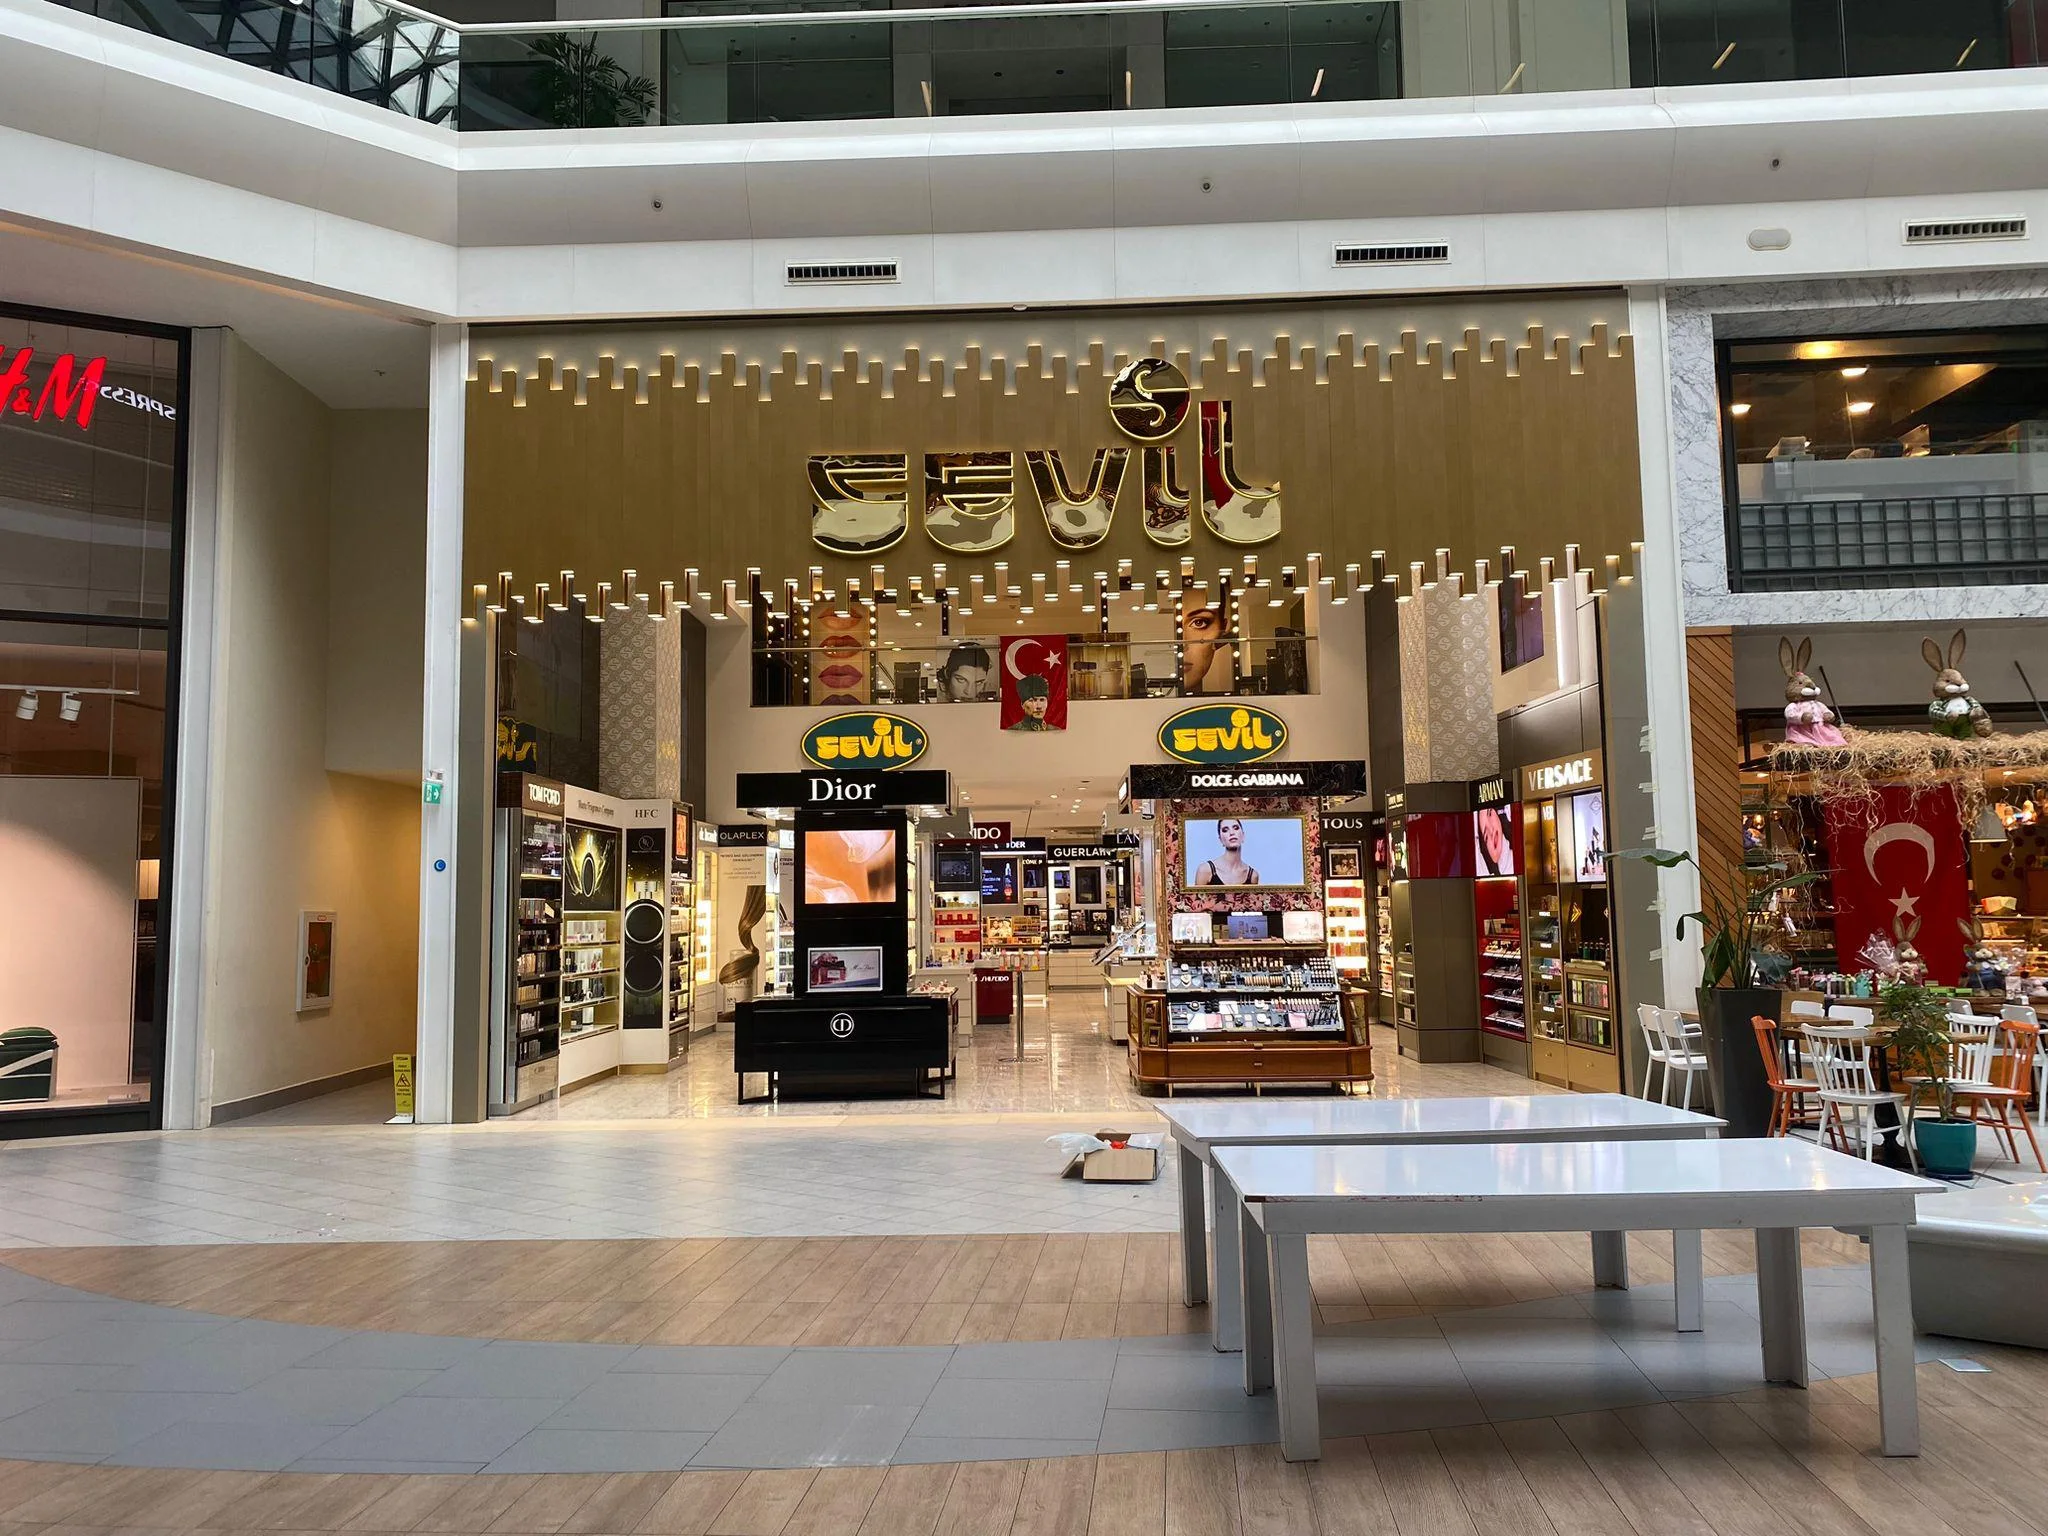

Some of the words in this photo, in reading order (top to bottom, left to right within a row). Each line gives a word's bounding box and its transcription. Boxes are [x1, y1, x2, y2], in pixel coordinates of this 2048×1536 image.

[0, 344, 107, 431] H&M
[1191, 773, 1304, 788] DOLCE&GABBANA
[1528, 757, 1594, 792] VERSACE
[528, 783, 544, 803] TOM
[544, 787, 561, 805] FORD
[808, 777, 877, 802] Dior
[635, 809, 659, 819] HFC
[1323, 818, 1363, 829] TOUS
[720, 831, 765, 840] OLAPLEX
[972, 827, 1001, 839] IDO
